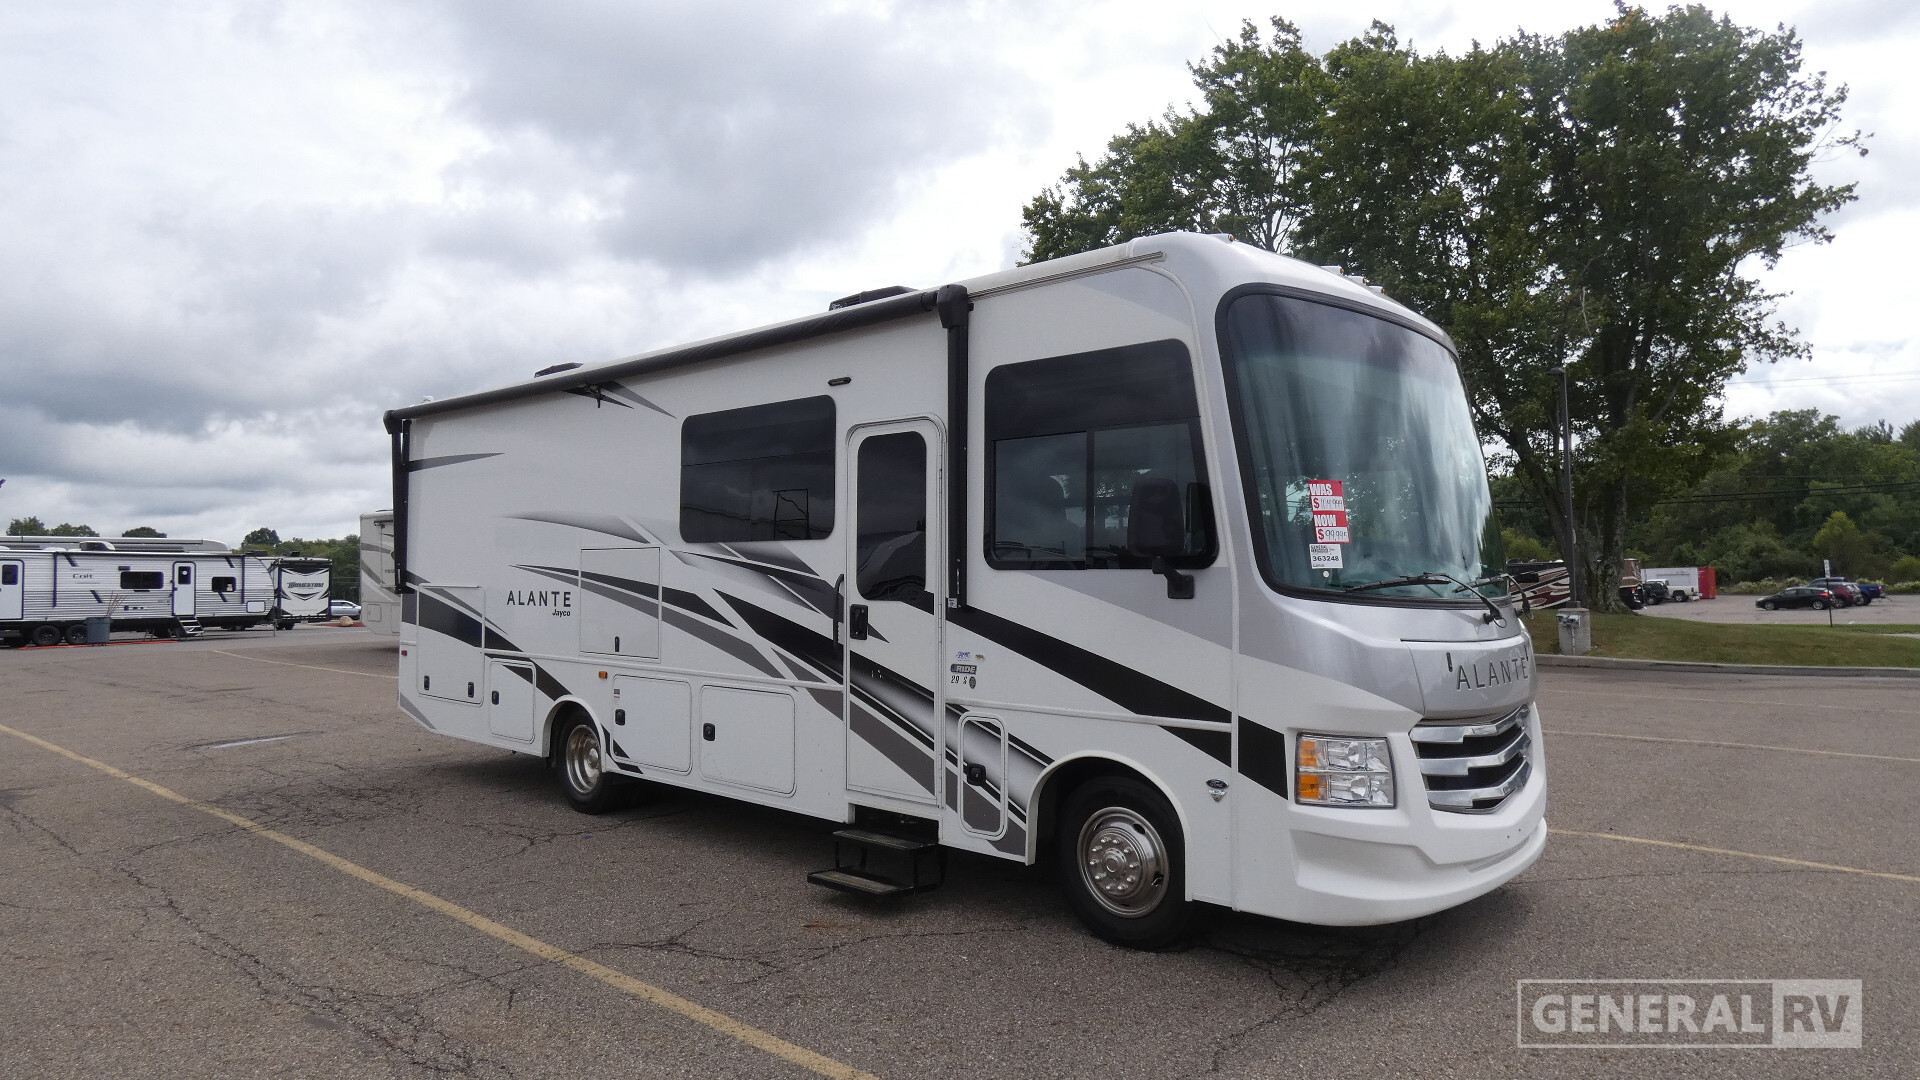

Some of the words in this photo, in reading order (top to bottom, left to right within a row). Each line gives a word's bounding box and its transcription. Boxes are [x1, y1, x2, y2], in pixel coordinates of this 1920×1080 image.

[1309, 483, 1333, 496] WAS
[1314, 514, 1337, 527] NOW
[506, 590, 572, 608] ALANTE
[552, 608, 571, 618] Jayco
[1456, 657, 1529, 691] ALANTE
